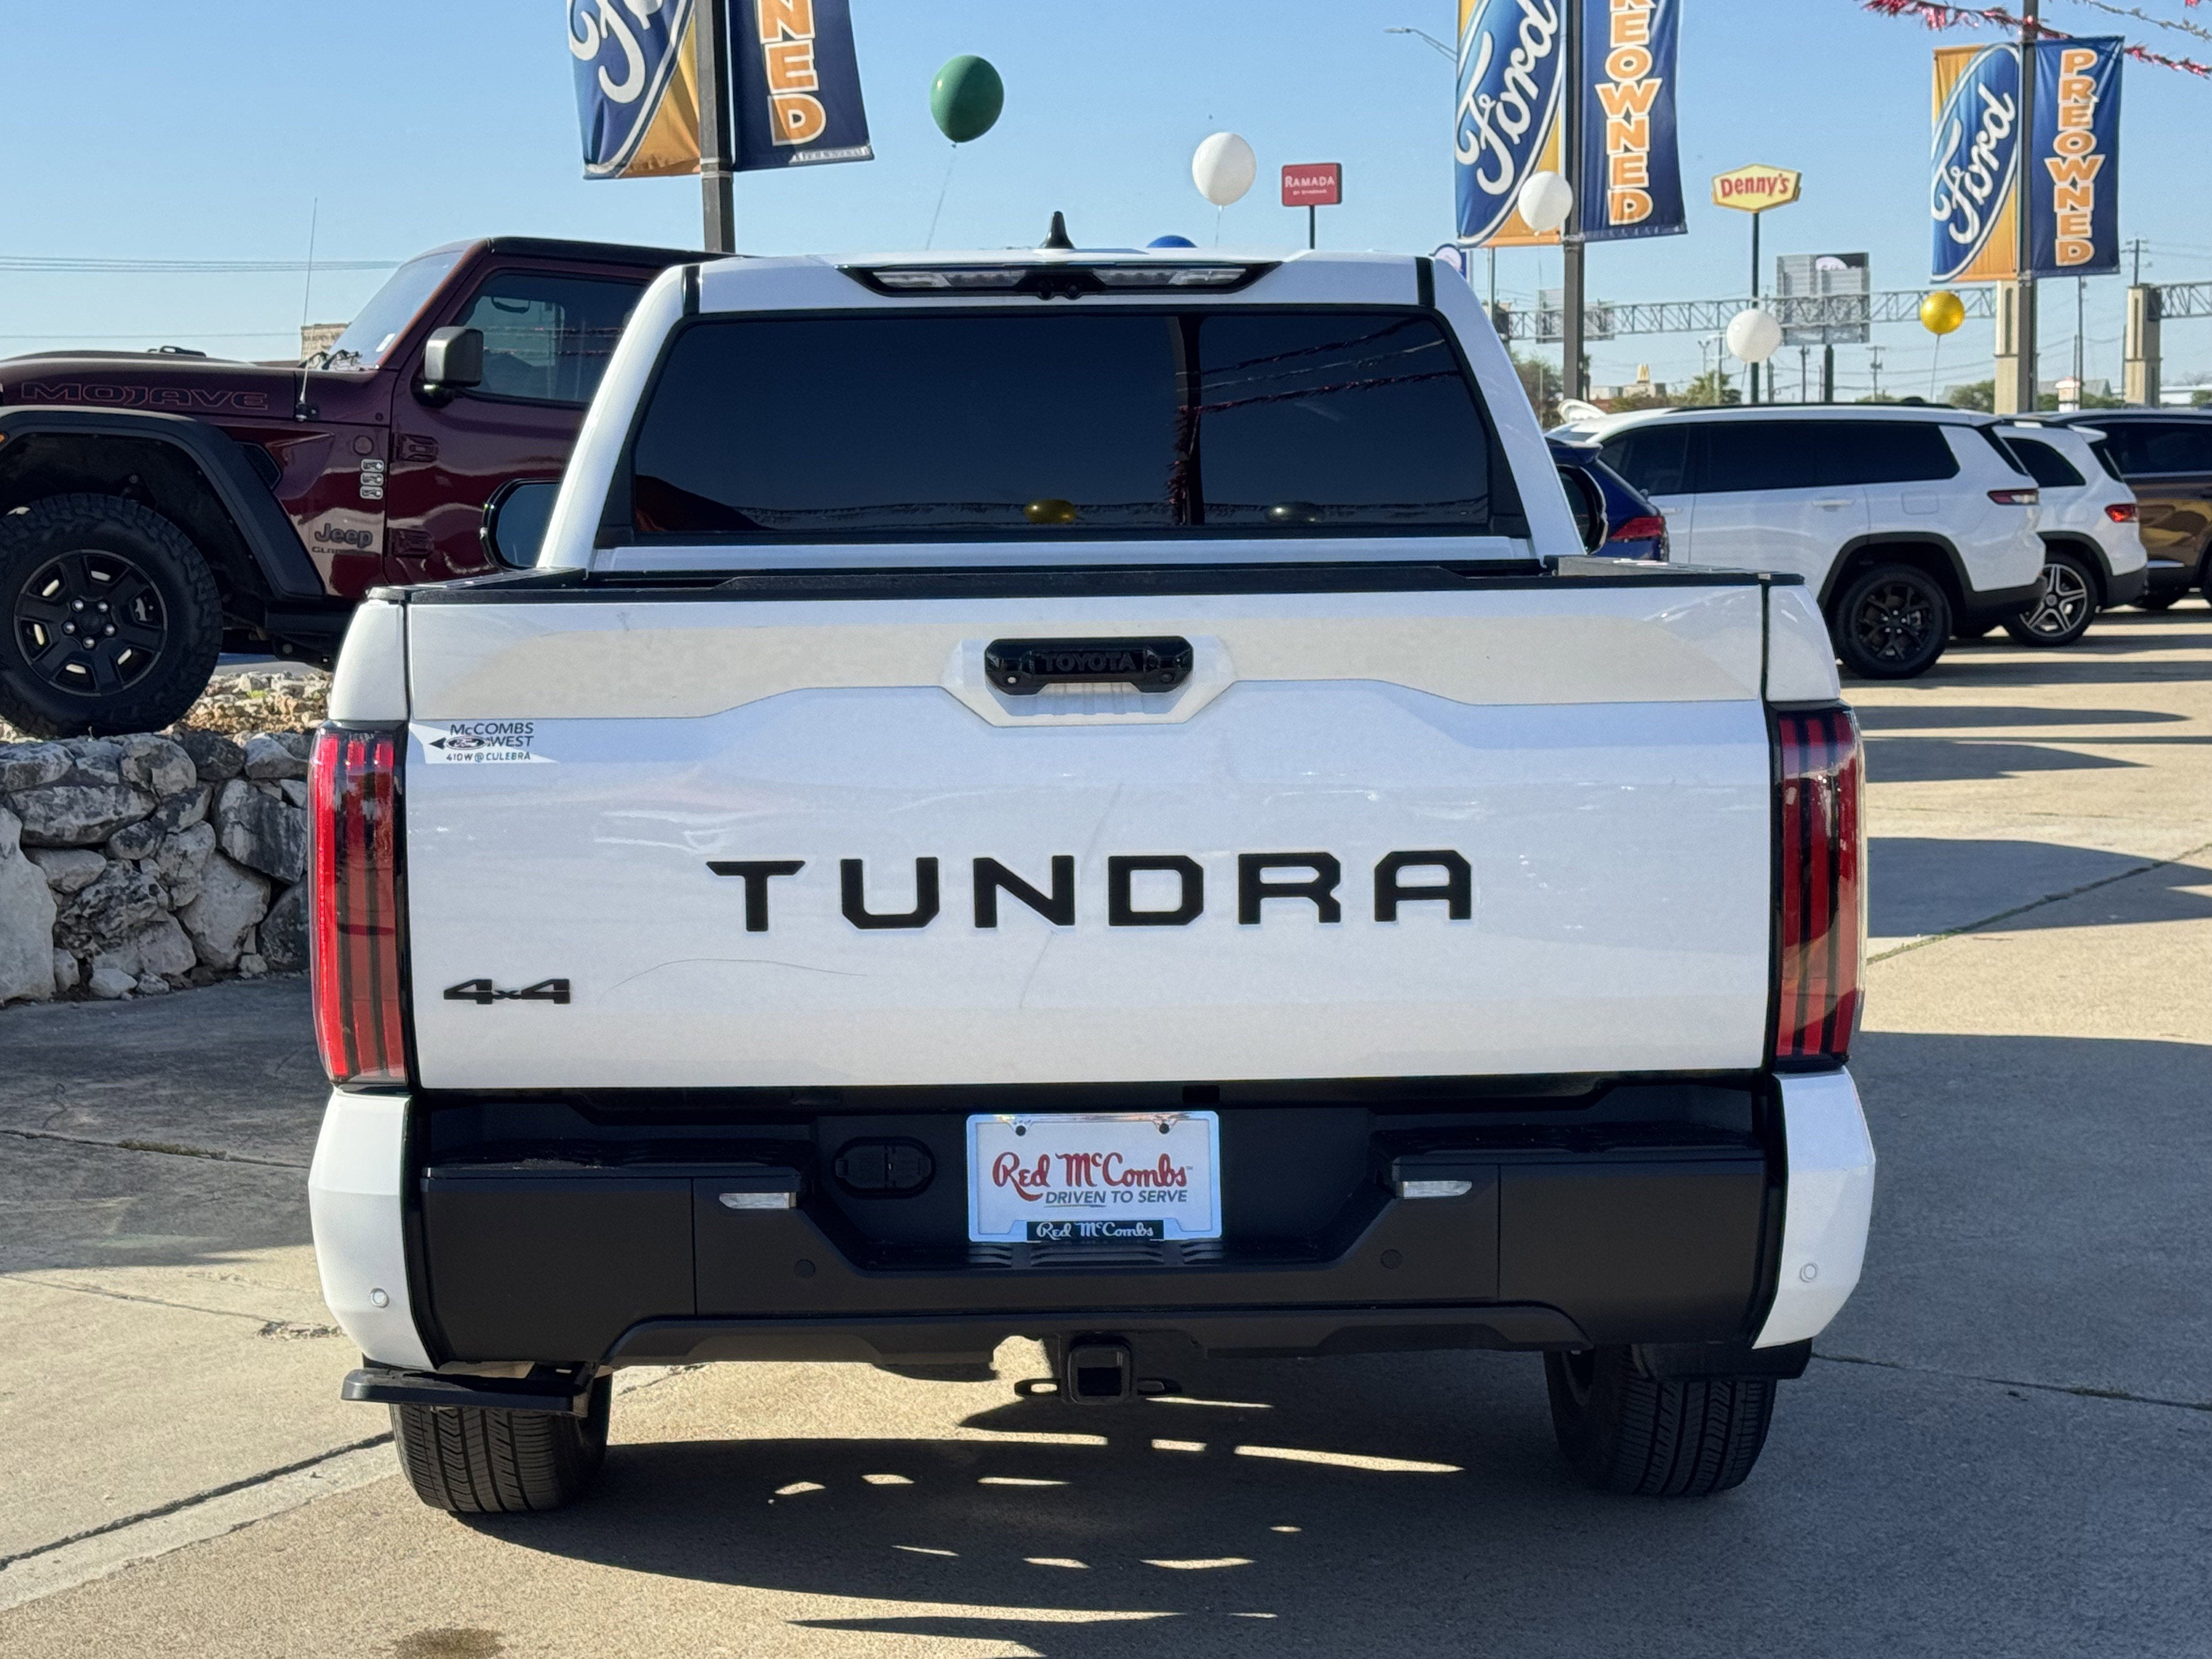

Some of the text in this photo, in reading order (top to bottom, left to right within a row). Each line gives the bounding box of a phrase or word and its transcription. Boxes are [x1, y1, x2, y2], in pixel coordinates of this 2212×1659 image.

[1455, 0, 1558, 195] Ford
[1931, 82, 2016, 245] Ford
[2044, 48, 2106, 267] PREOWNED
[1285, 176, 1335, 188] RAMADA
[1720, 172, 1791, 198] Denny's
[21, 382, 269, 410] MOJAVE
[314, 523, 374, 549] Jeep
[1044, 653, 1137, 672] TOYOTA
[450, 722, 534, 735] McCOMBS
[706, 849, 1474, 933] TUNDRA
[443, 979, 571, 1005] 4x4
[992, 1152, 1187, 1201] Red McCombs
[1046, 1189, 1188, 1204] DRIVEN TO SERVE
[1036, 1222, 1154, 1240] Red McCombs
